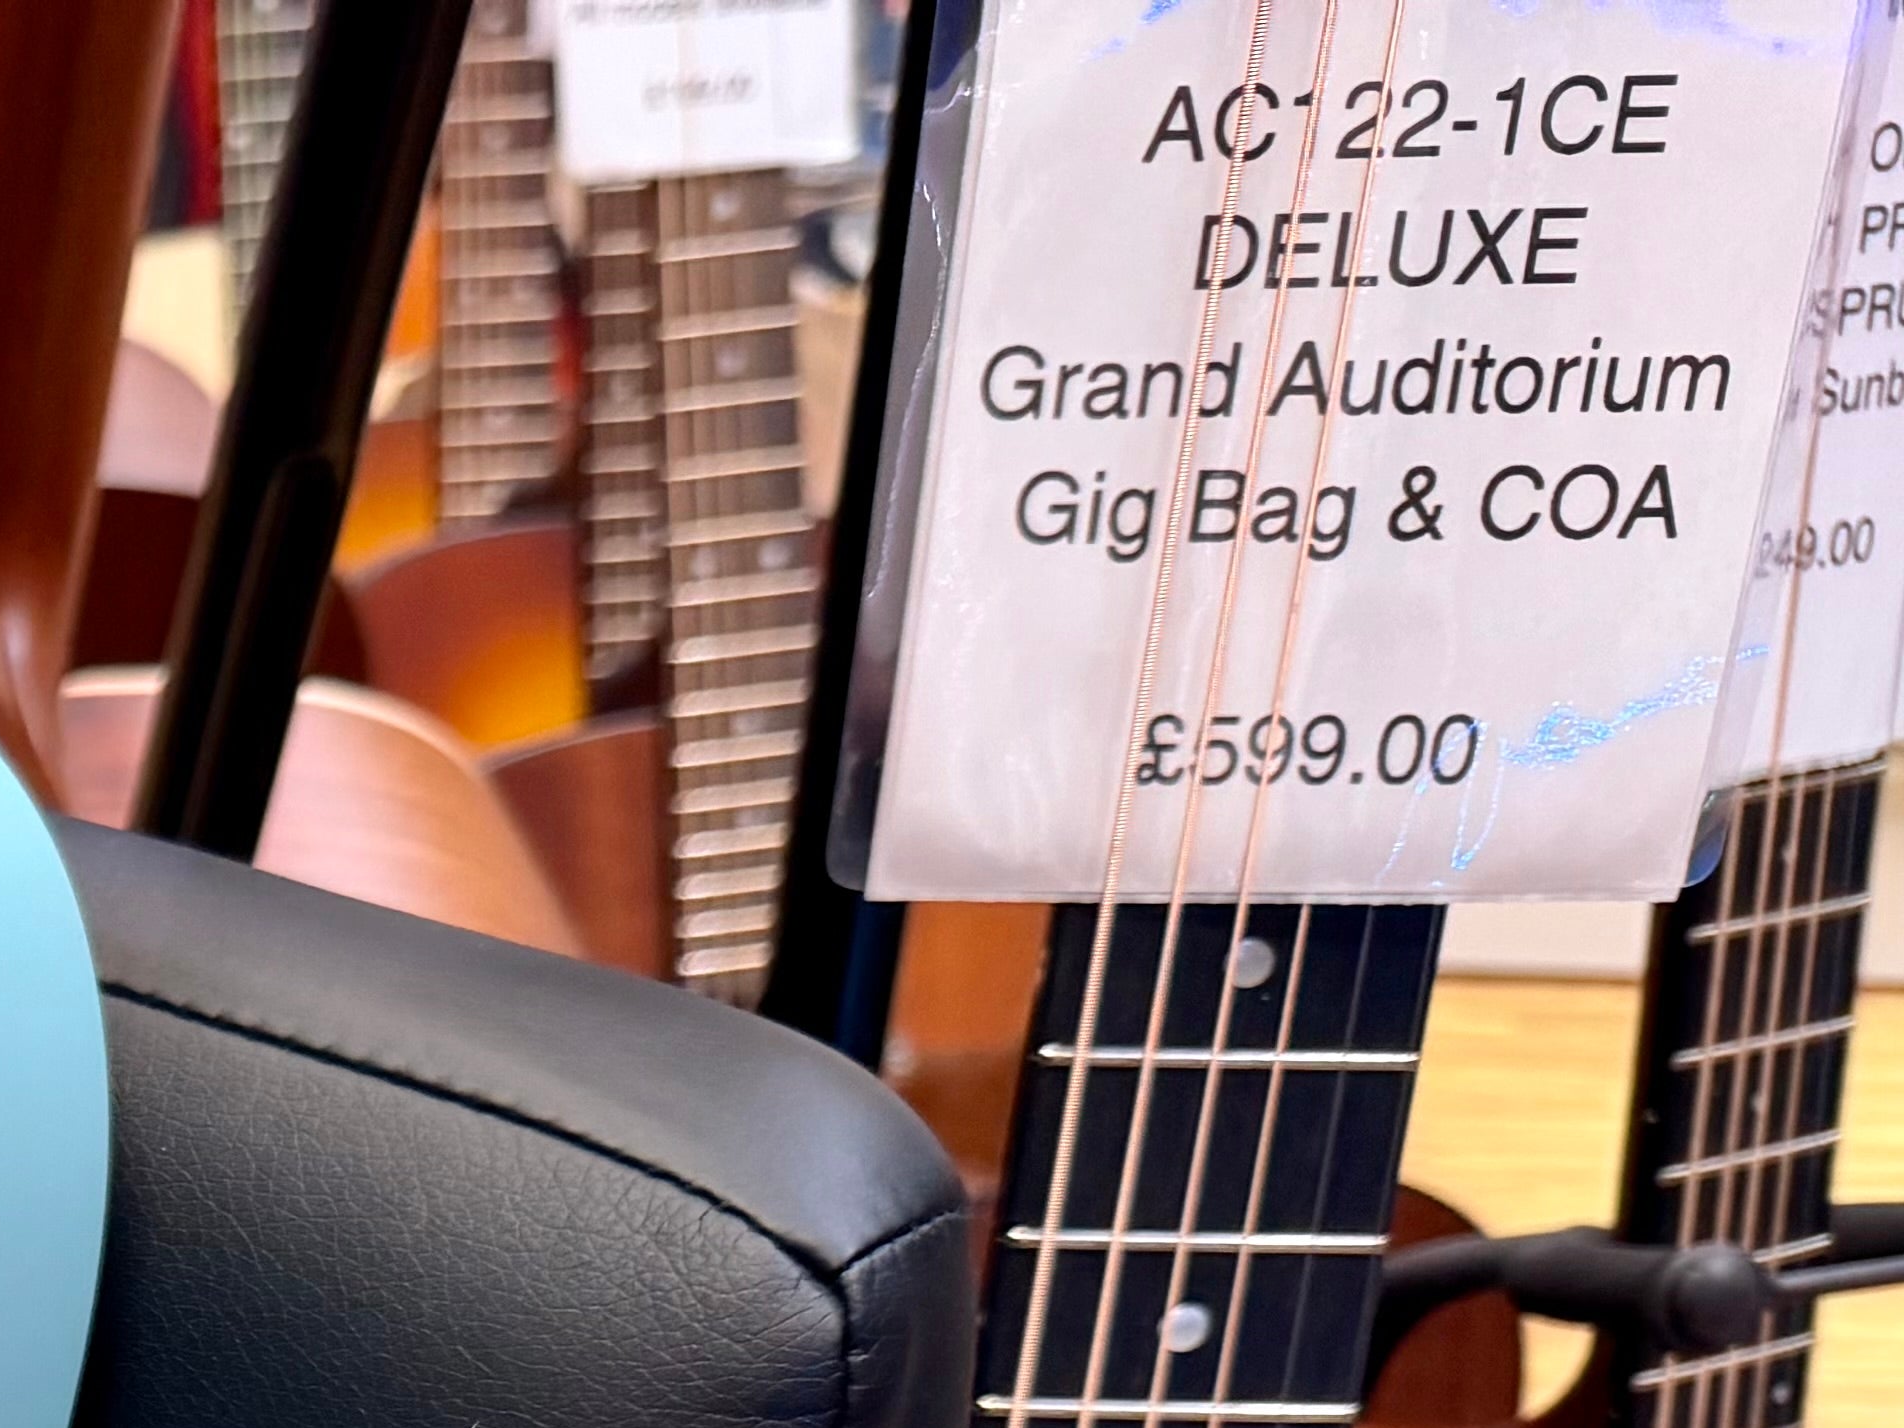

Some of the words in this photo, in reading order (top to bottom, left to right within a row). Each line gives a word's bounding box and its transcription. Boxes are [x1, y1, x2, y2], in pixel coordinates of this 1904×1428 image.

[1193, 207, 1589, 290] DELUXE
[980, 343, 1243, 421] Grand
[1266, 337, 1731, 416] Auditorium
[1015, 469, 1156, 563] Gig
[1187, 469, 1357, 562] Bag
[1388, 465, 1444, 543] &
[1480, 464, 1677, 542] COA
[1136, 713, 1479, 786] £599.00
